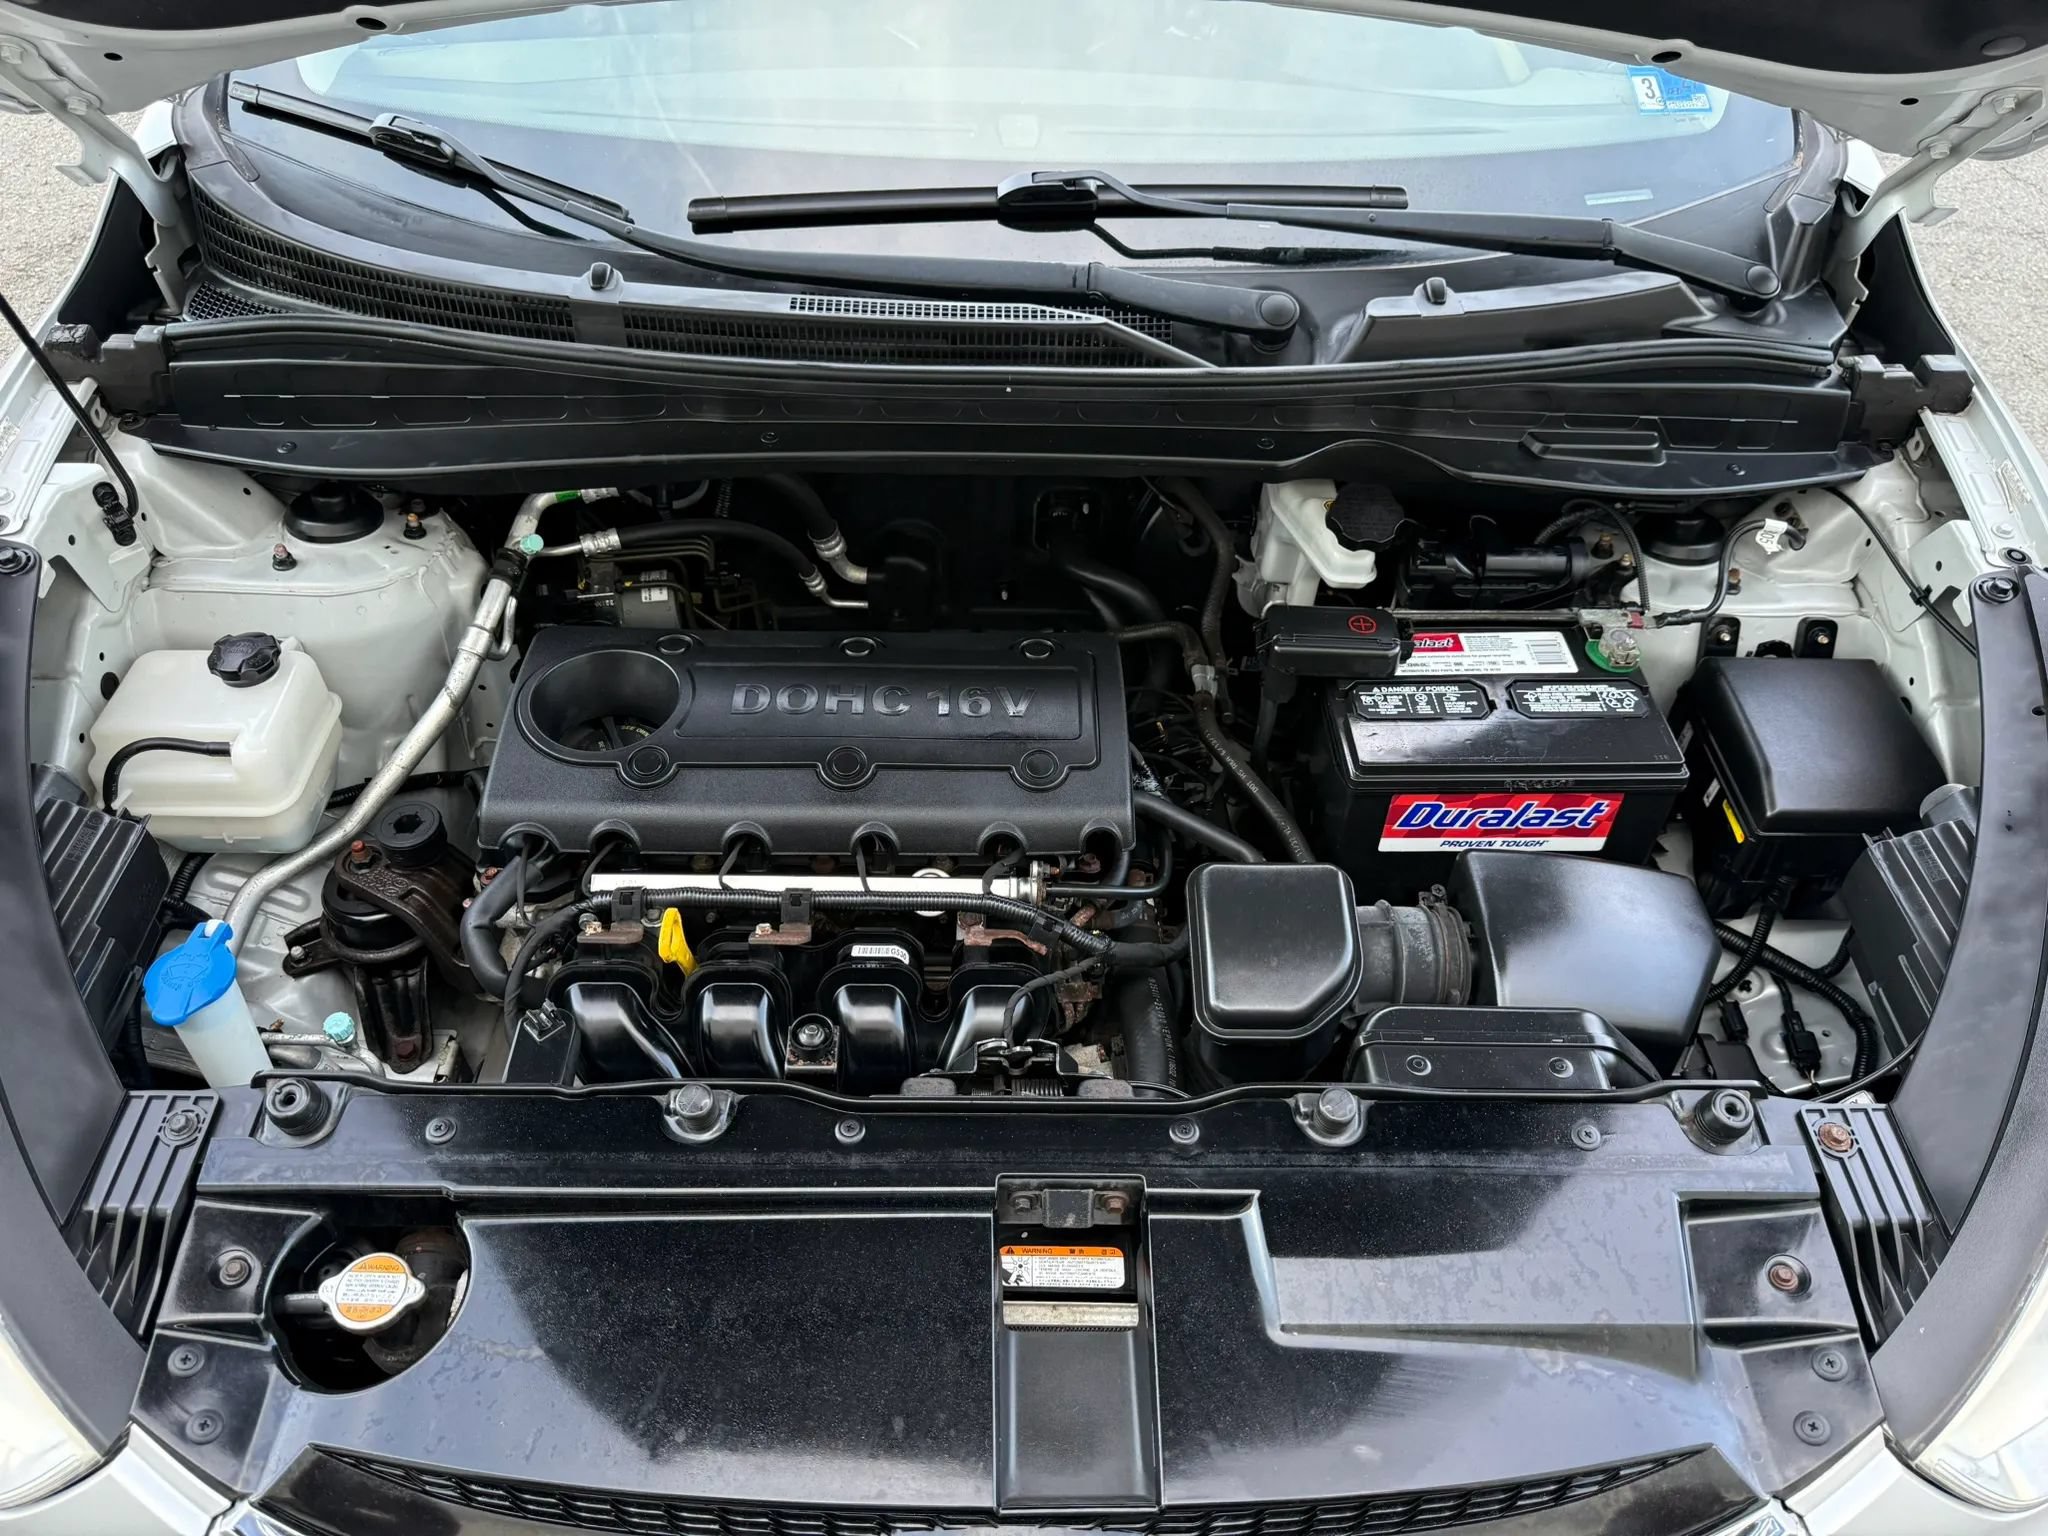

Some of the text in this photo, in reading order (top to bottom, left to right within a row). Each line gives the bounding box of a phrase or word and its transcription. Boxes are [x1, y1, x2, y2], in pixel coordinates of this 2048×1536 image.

[1640, 77, 1656, 100] 3
[1413, 638, 1454, 648] alast
[730, 683, 1037, 718] DOHC 16V
[1392, 801, 1611, 830] Duralast
[1440, 840, 1496, 848] PROVEN
[367, 1263, 400, 1271] WARNING
